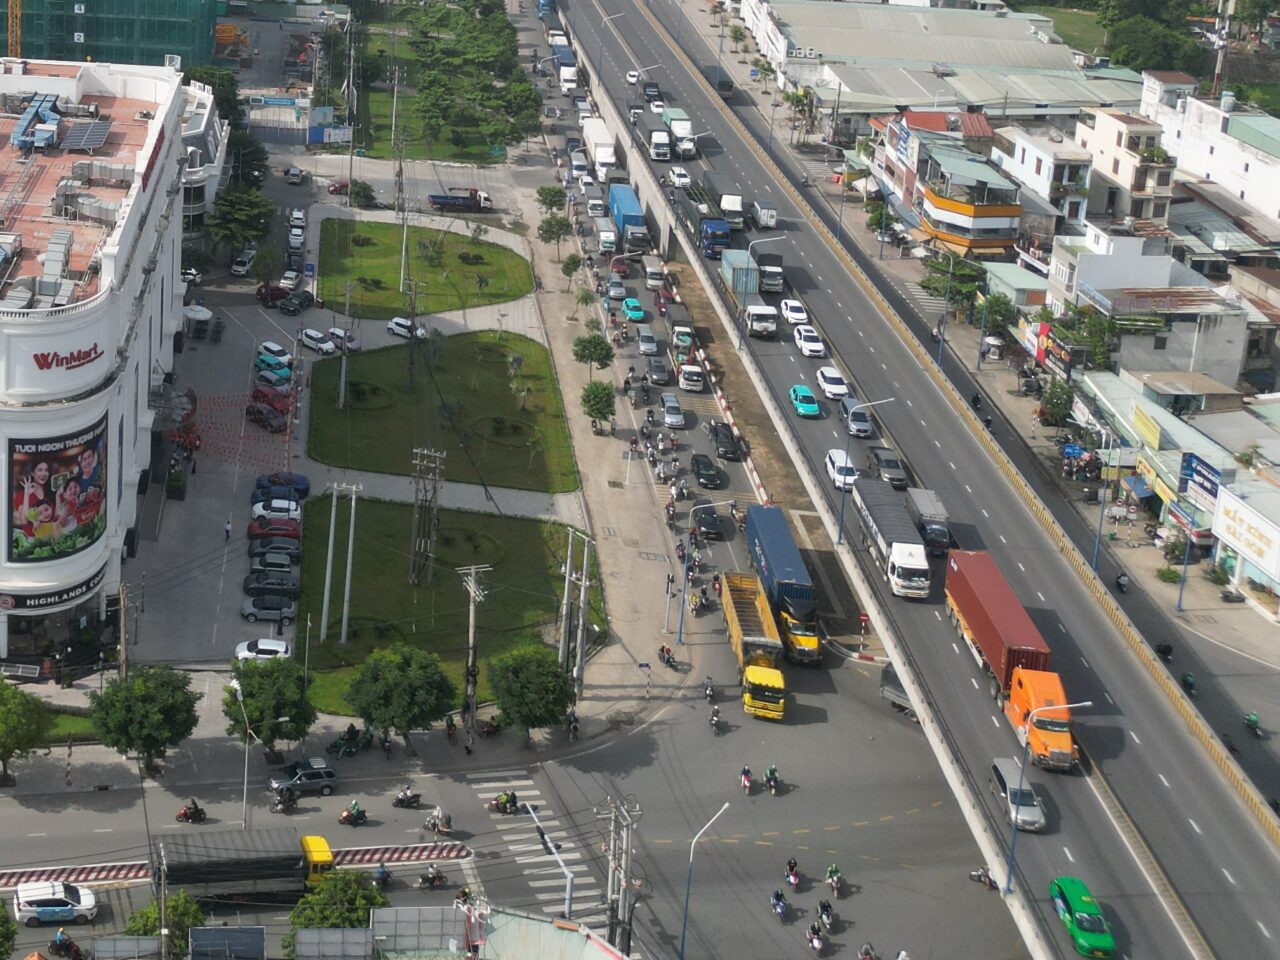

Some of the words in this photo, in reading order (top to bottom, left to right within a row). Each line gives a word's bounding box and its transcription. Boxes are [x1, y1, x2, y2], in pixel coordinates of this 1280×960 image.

[33, 342, 98, 370] WinMart
[38, 442, 64, 452] NGON
[26, 584, 88, 606] HIGHLANDS
